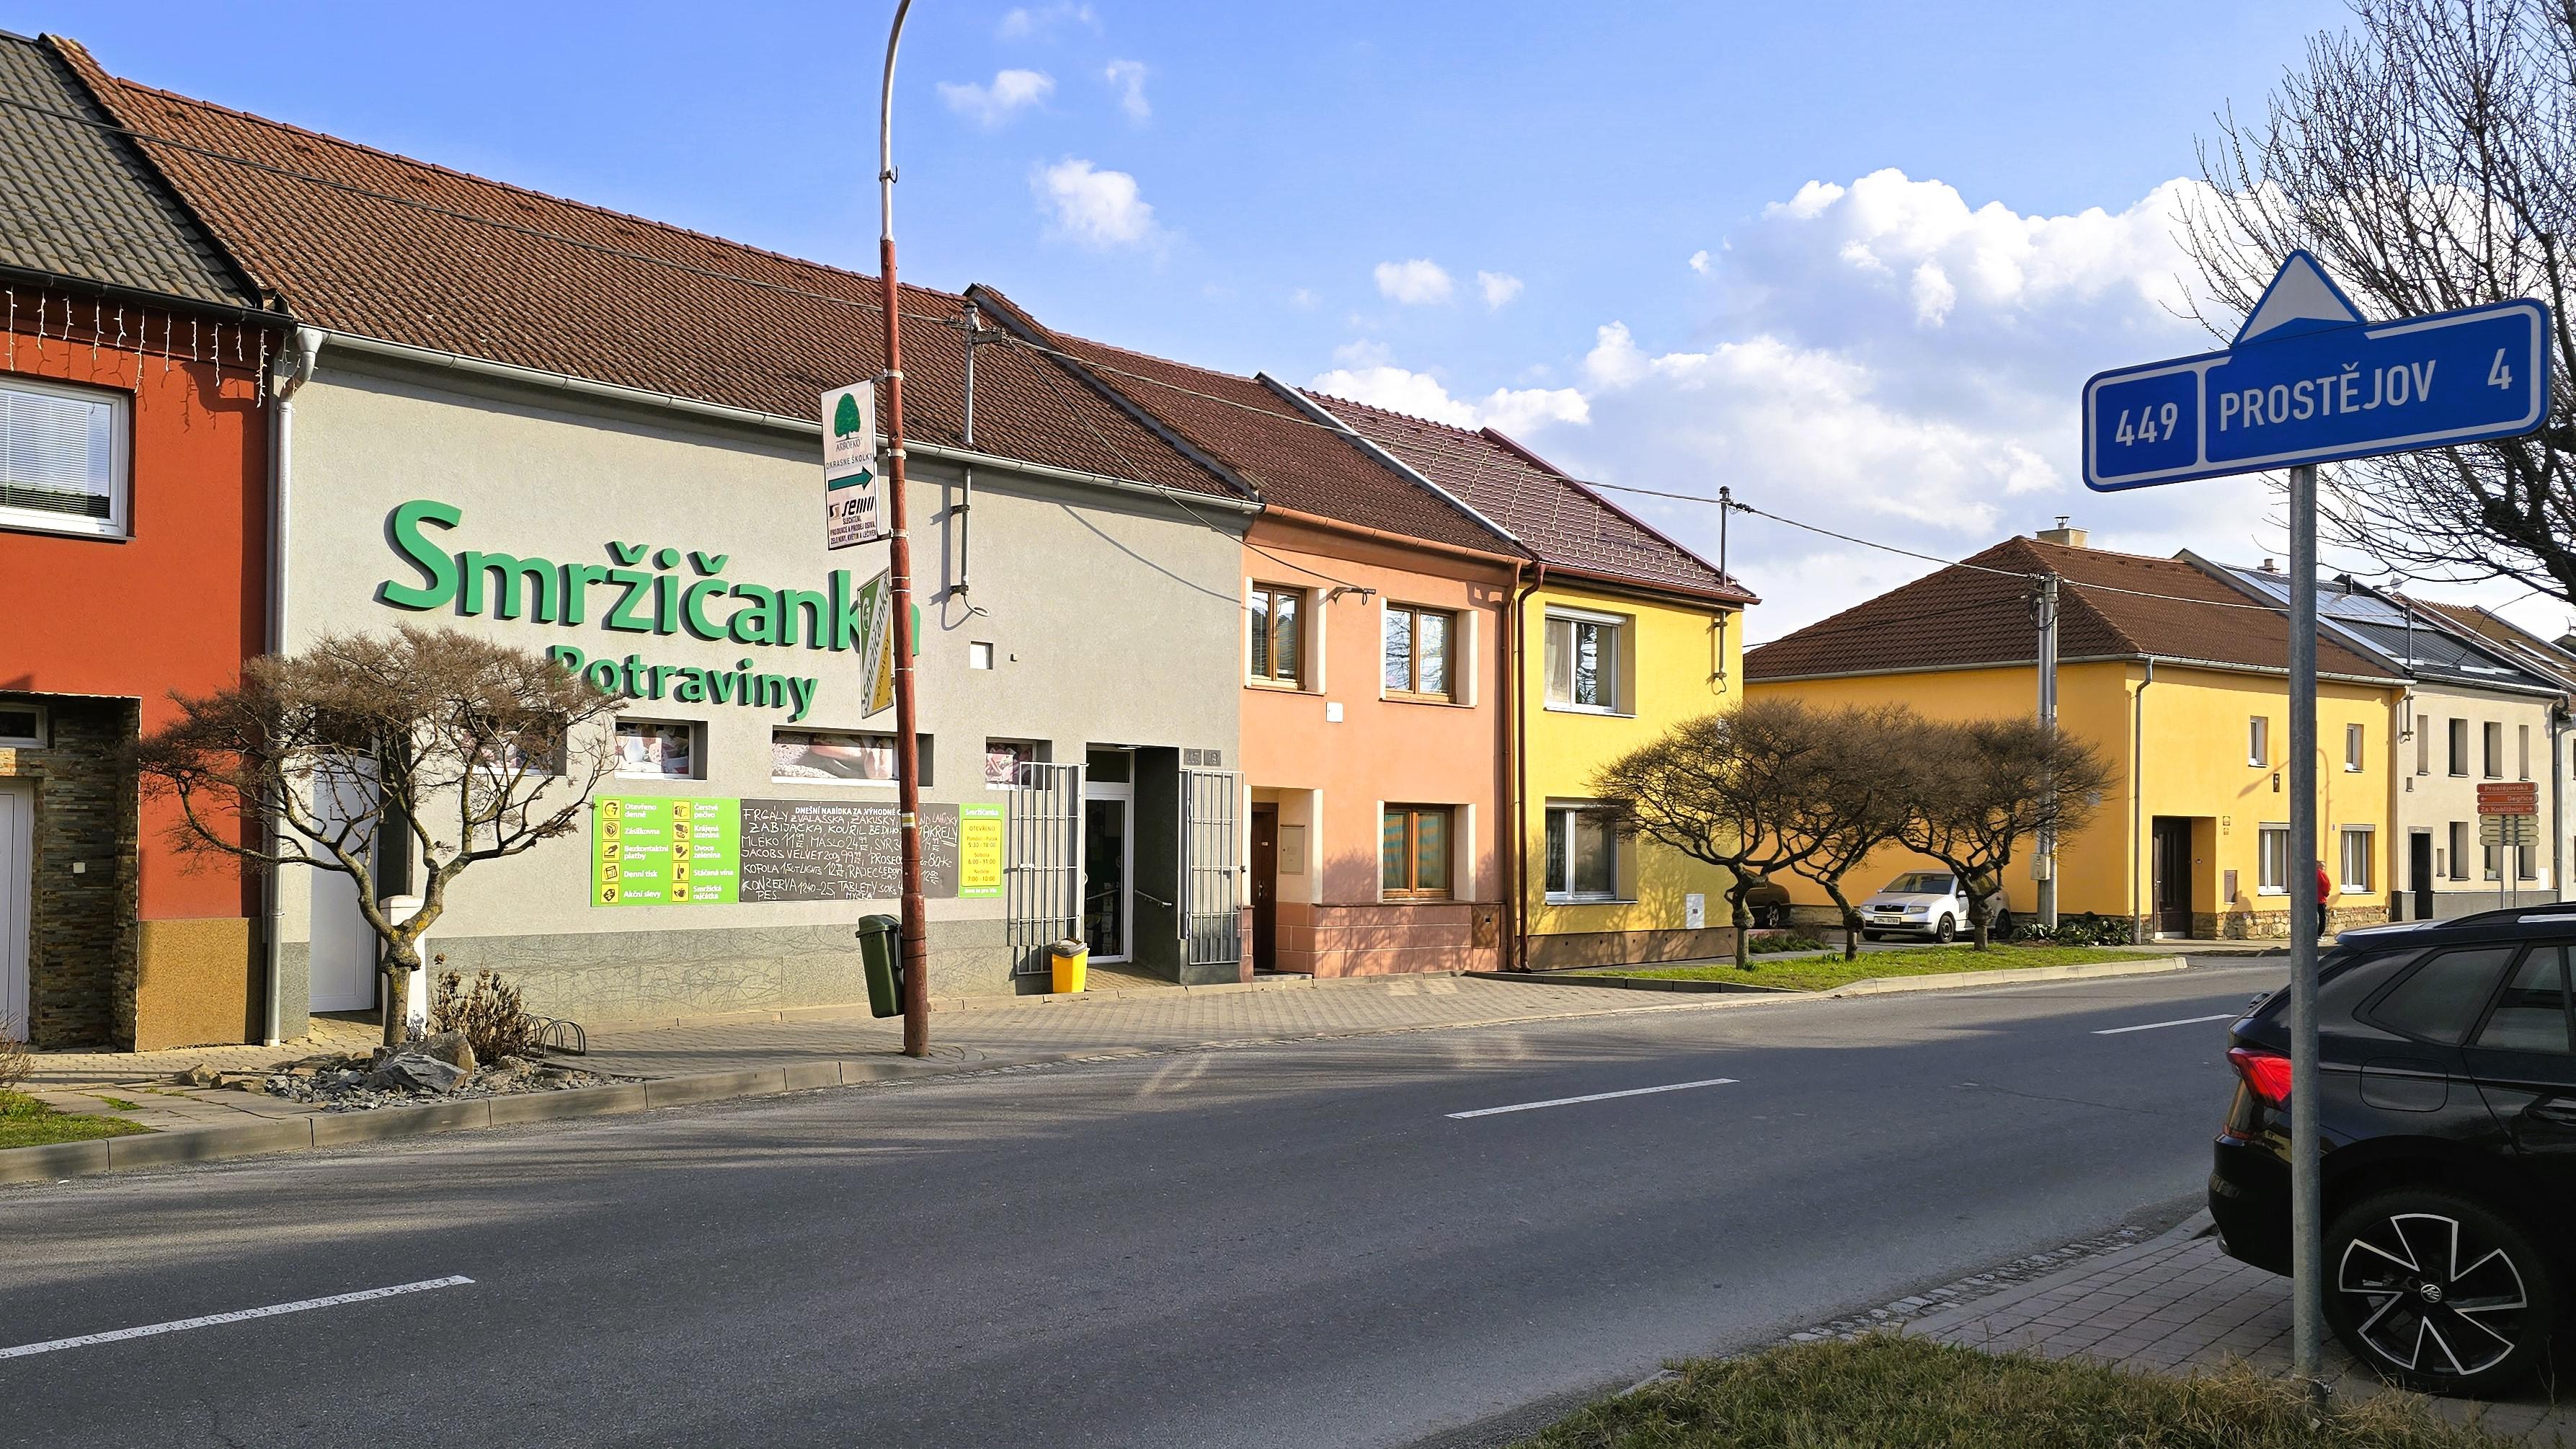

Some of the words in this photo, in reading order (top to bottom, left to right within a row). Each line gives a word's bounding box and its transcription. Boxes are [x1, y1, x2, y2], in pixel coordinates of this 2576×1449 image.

[2115, 402, 2179, 446] 449
[2220, 360, 2436, 432] PROSTĚJOV
[2487, 348, 2513, 390] 4
[373, 500, 920, 656] Smržičank
[546, 645, 818, 722] Potraviny
[742, 805, 789, 823] FRGÁLY
[795, 806, 820, 815] DNEŠNÍ
[822, 807, 852, 815] NABÍDKA
[864, 807, 896, 816] VÝHODNÉ
[623, 852, 647, 861] platby
[741, 848, 785, 859] JACOBS
[786, 848, 823, 860] VELVET
[623, 869, 644, 878] Denní
[743, 861, 780, 874] KOFOLA
[623, 890, 644, 898] Akční
[838, 880, 878, 895] TABLETY
